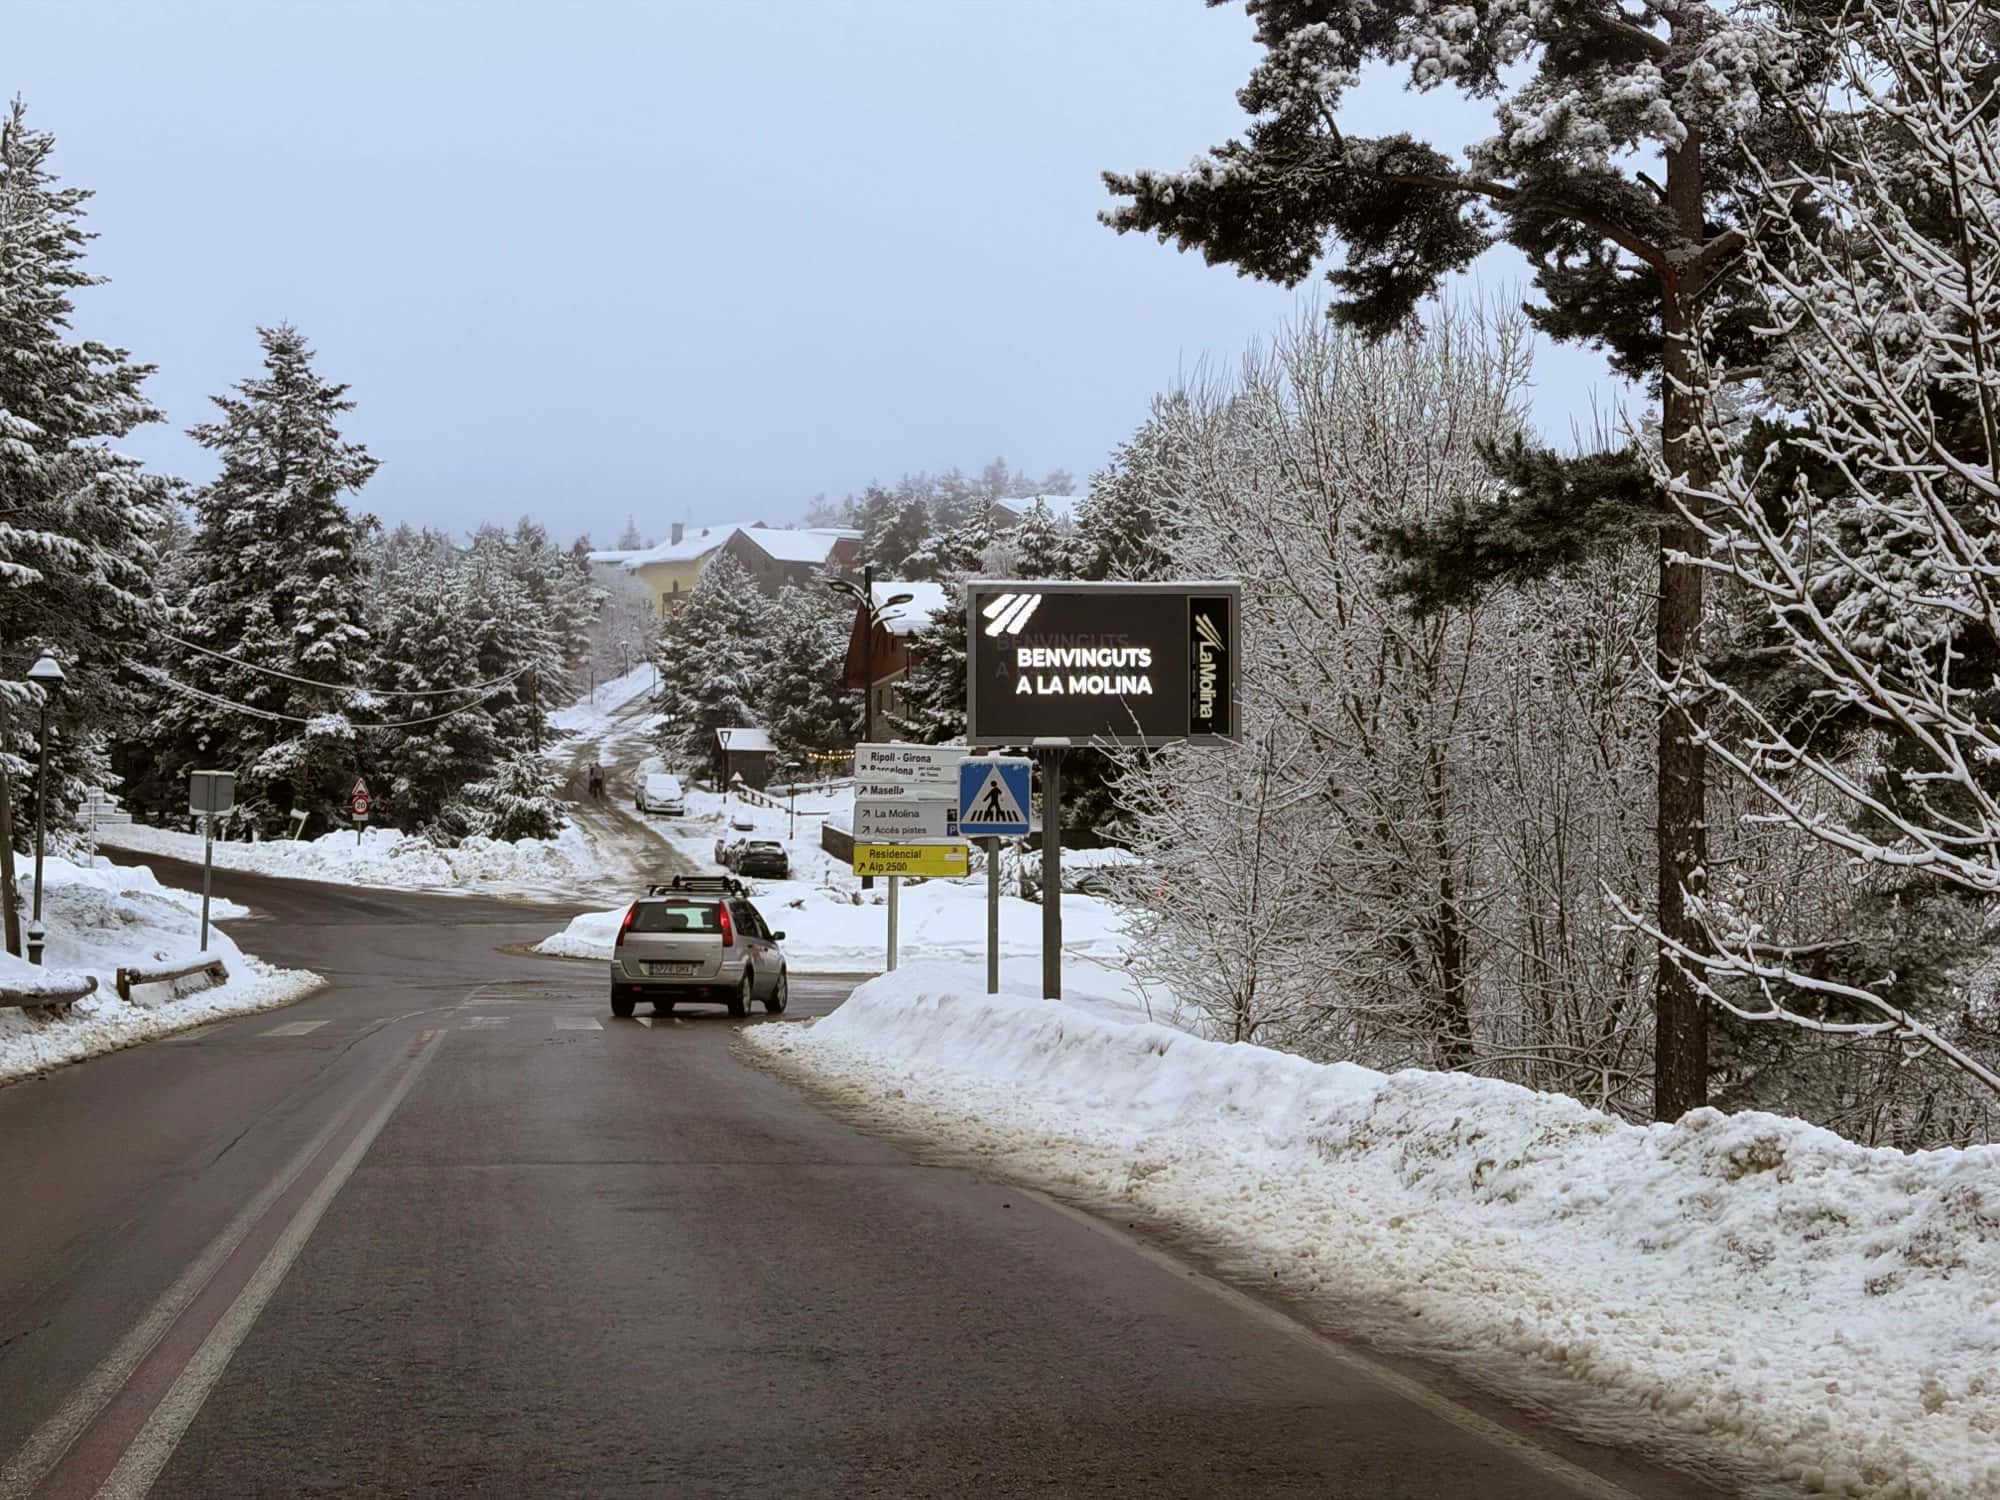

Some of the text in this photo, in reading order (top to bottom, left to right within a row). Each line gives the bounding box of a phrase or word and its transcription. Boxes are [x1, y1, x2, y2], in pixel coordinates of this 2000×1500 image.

[1017, 648, 1152, 667] BENVINGUTS
[1016, 675, 1153, 694] A LA MOLINA
[871, 752, 895, 763] Ripoll
[903, 753, 931, 763] Girona
[870, 786, 904, 795] Masella
[875, 809, 919, 818] La Molina
[902, 826, 926, 836] pistes
[869, 849, 921, 859] Residencial
[869, 862, 907, 873] Alp 2500
